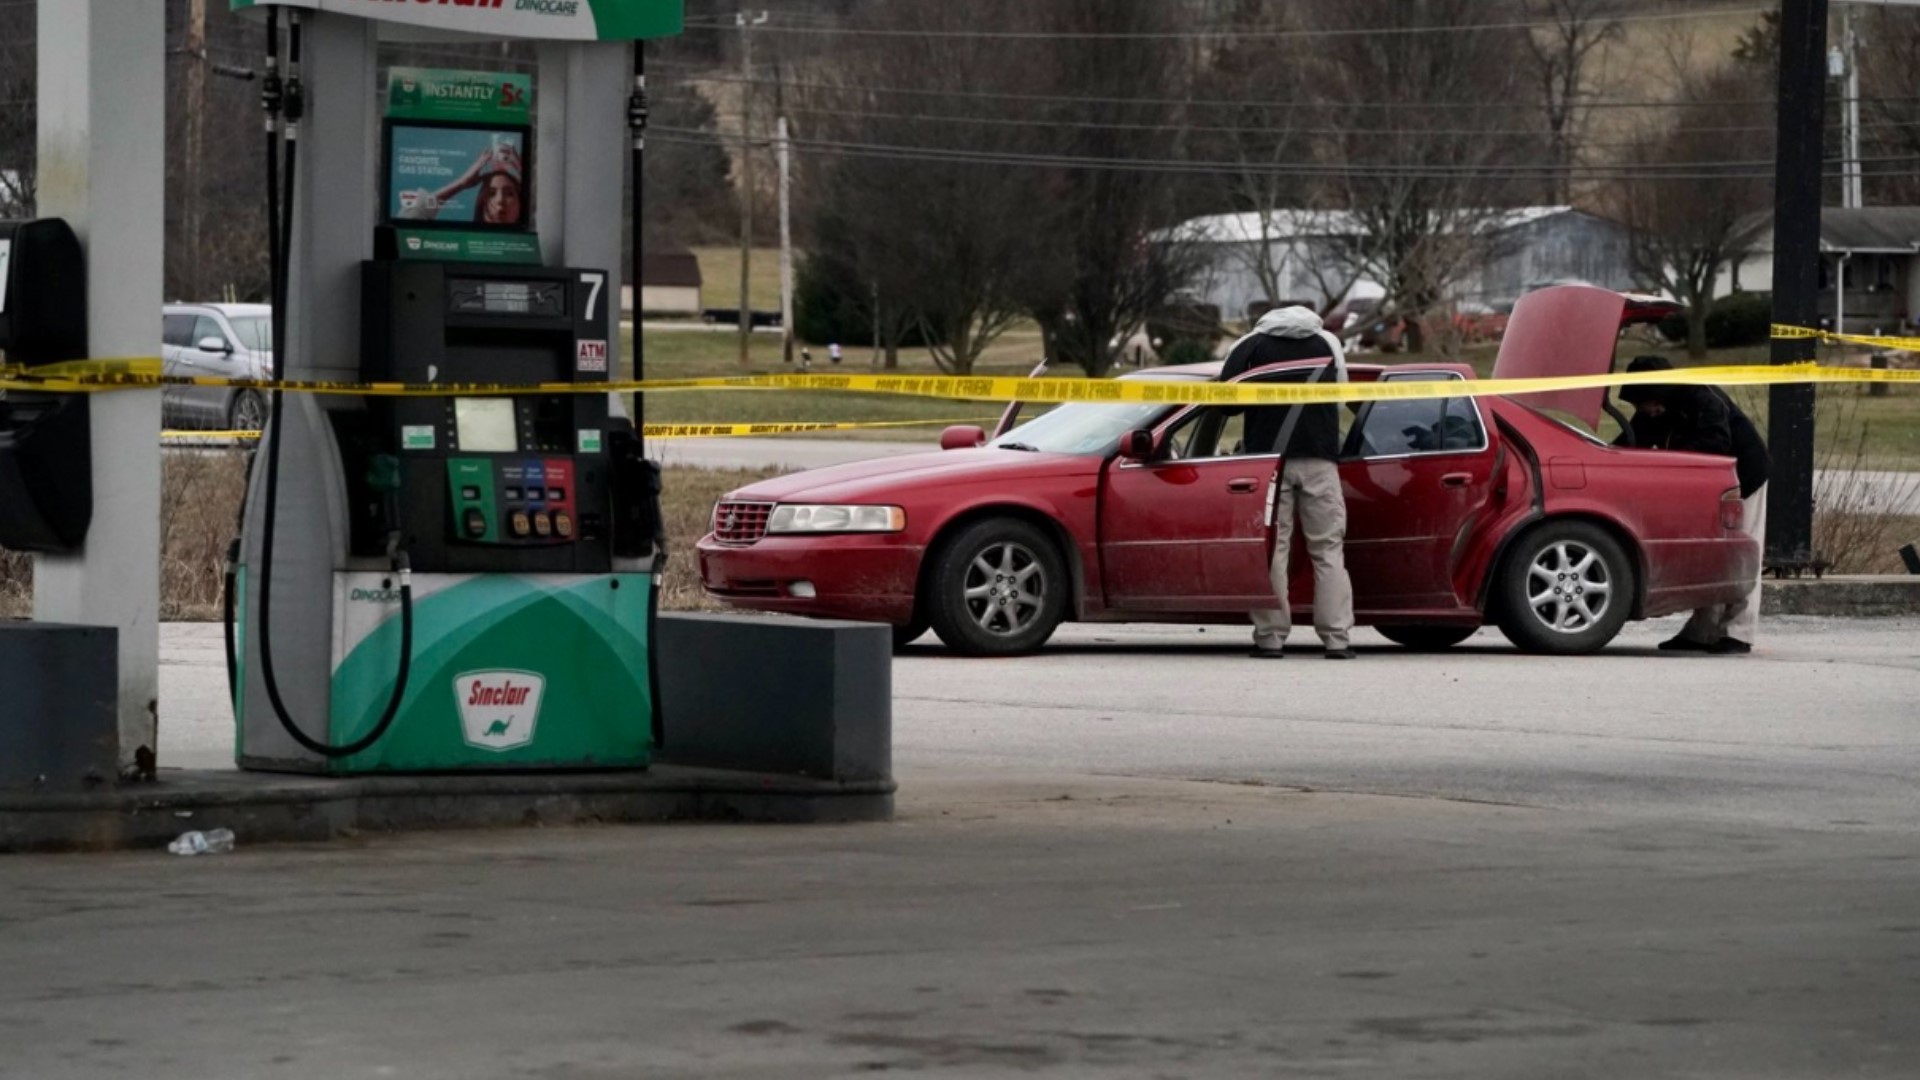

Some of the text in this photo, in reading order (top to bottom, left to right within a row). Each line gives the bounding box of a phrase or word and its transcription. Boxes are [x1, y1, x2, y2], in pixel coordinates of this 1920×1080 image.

[515, 0, 579, 14] DINOCARE
[425, 83, 494, 100] INSTANTLY
[580, 273, 604, 320] 7
[581, 343, 605, 357] ATM
[580, 359, 605, 369] INSIDE
[351, 588, 403, 601] DINOCAR
[469, 680, 530, 705] Sinclair
